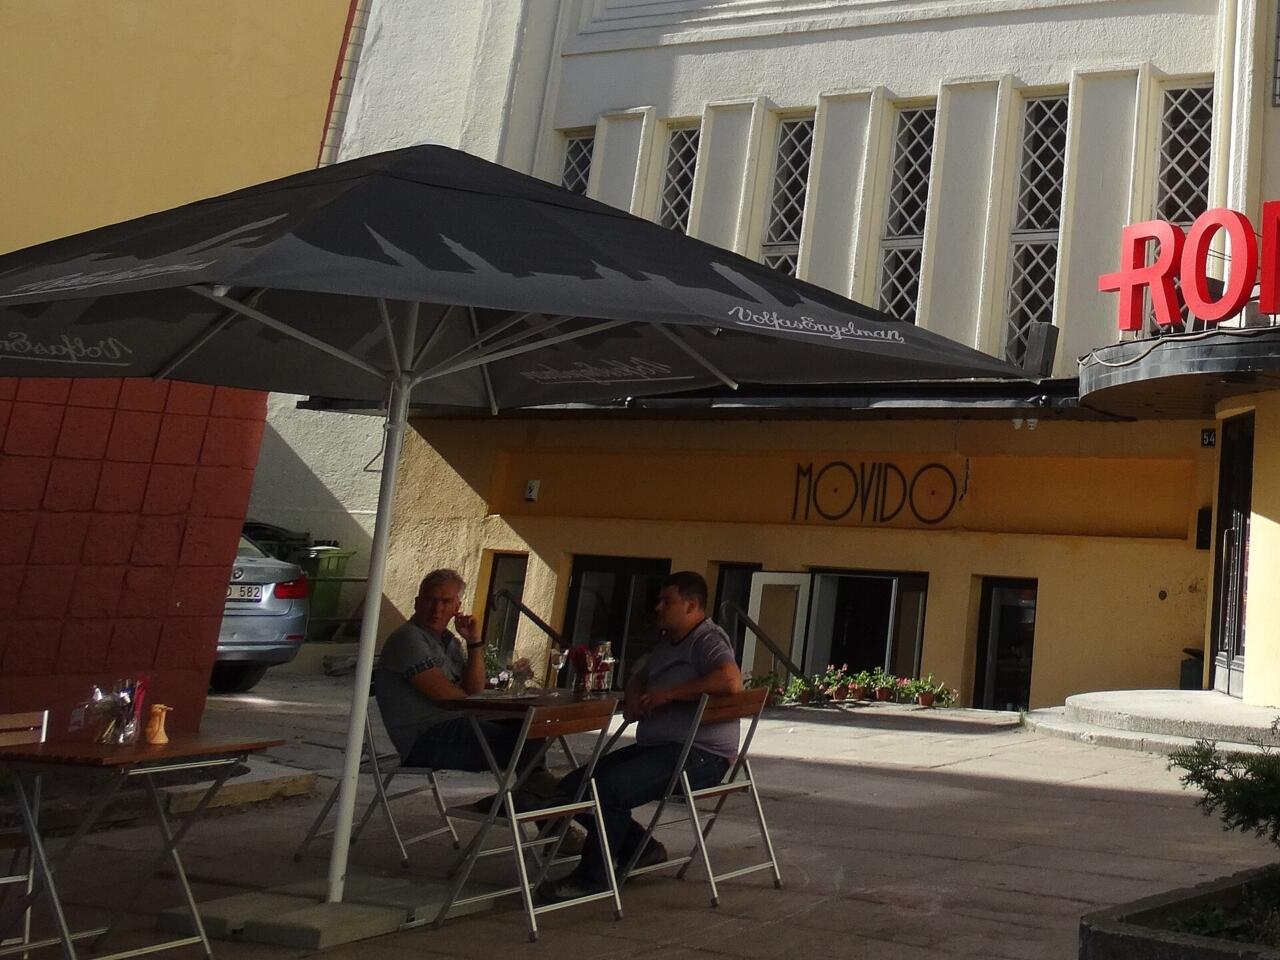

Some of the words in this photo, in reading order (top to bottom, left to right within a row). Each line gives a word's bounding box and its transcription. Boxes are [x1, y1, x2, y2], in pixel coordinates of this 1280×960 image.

[1203, 431, 1215, 445] 54
[791, 460, 957, 524] MOVIDO
[239, 586, 260, 598] 582
